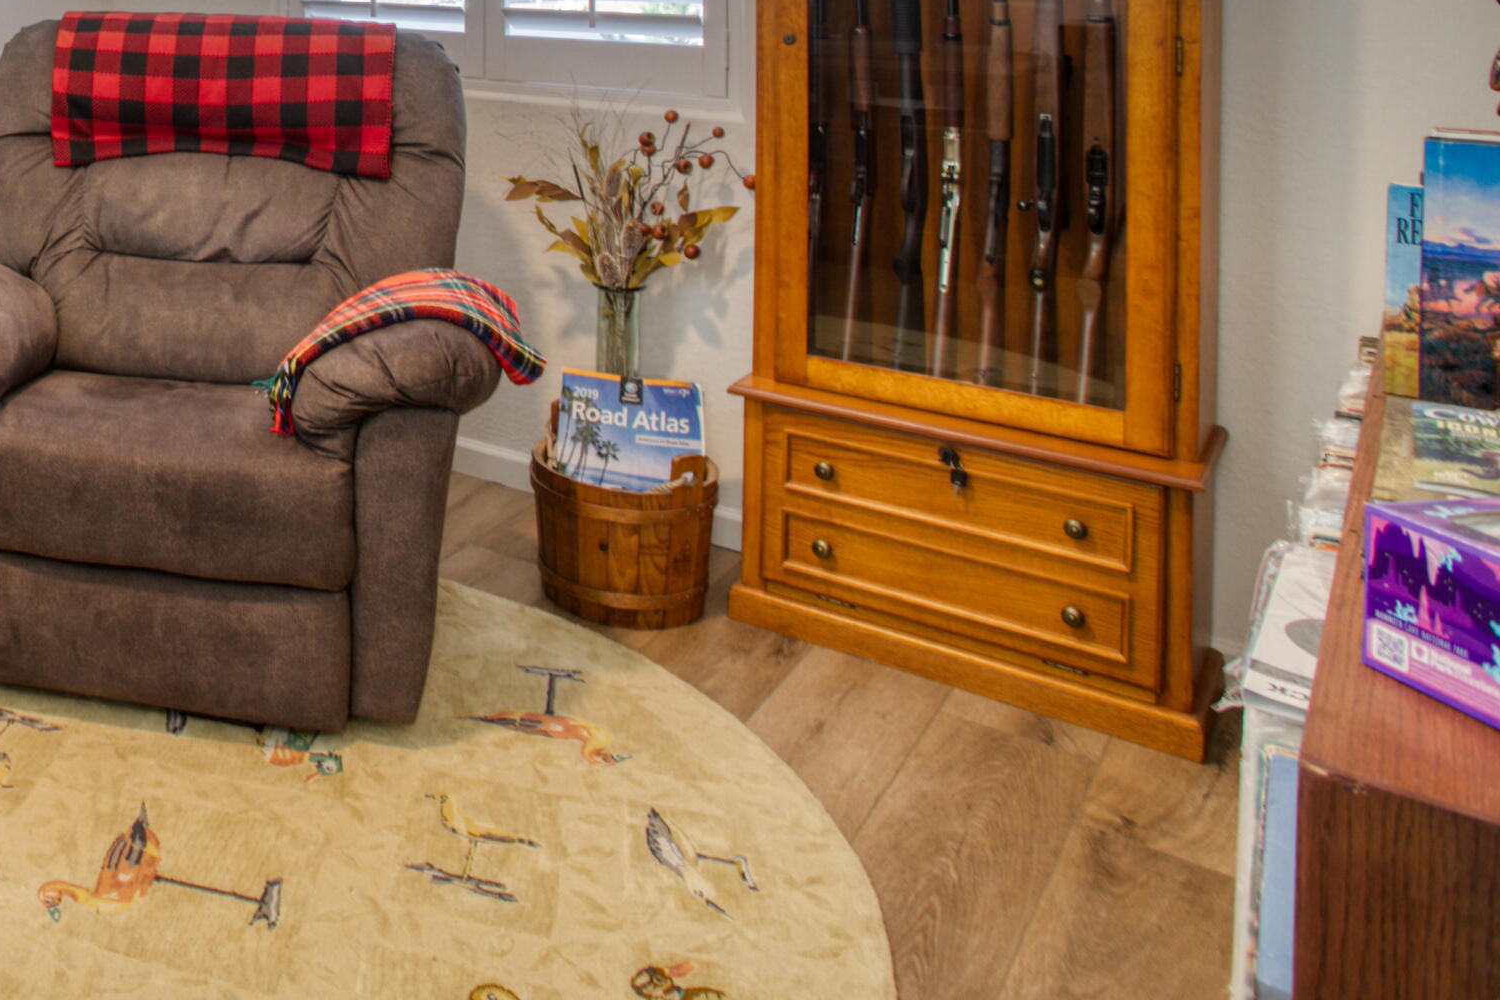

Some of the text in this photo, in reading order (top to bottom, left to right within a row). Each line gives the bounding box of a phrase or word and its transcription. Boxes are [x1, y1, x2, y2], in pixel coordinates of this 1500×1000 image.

[573, 386, 600, 400] 2019
[571, 401, 691, 435] Road Atlas
